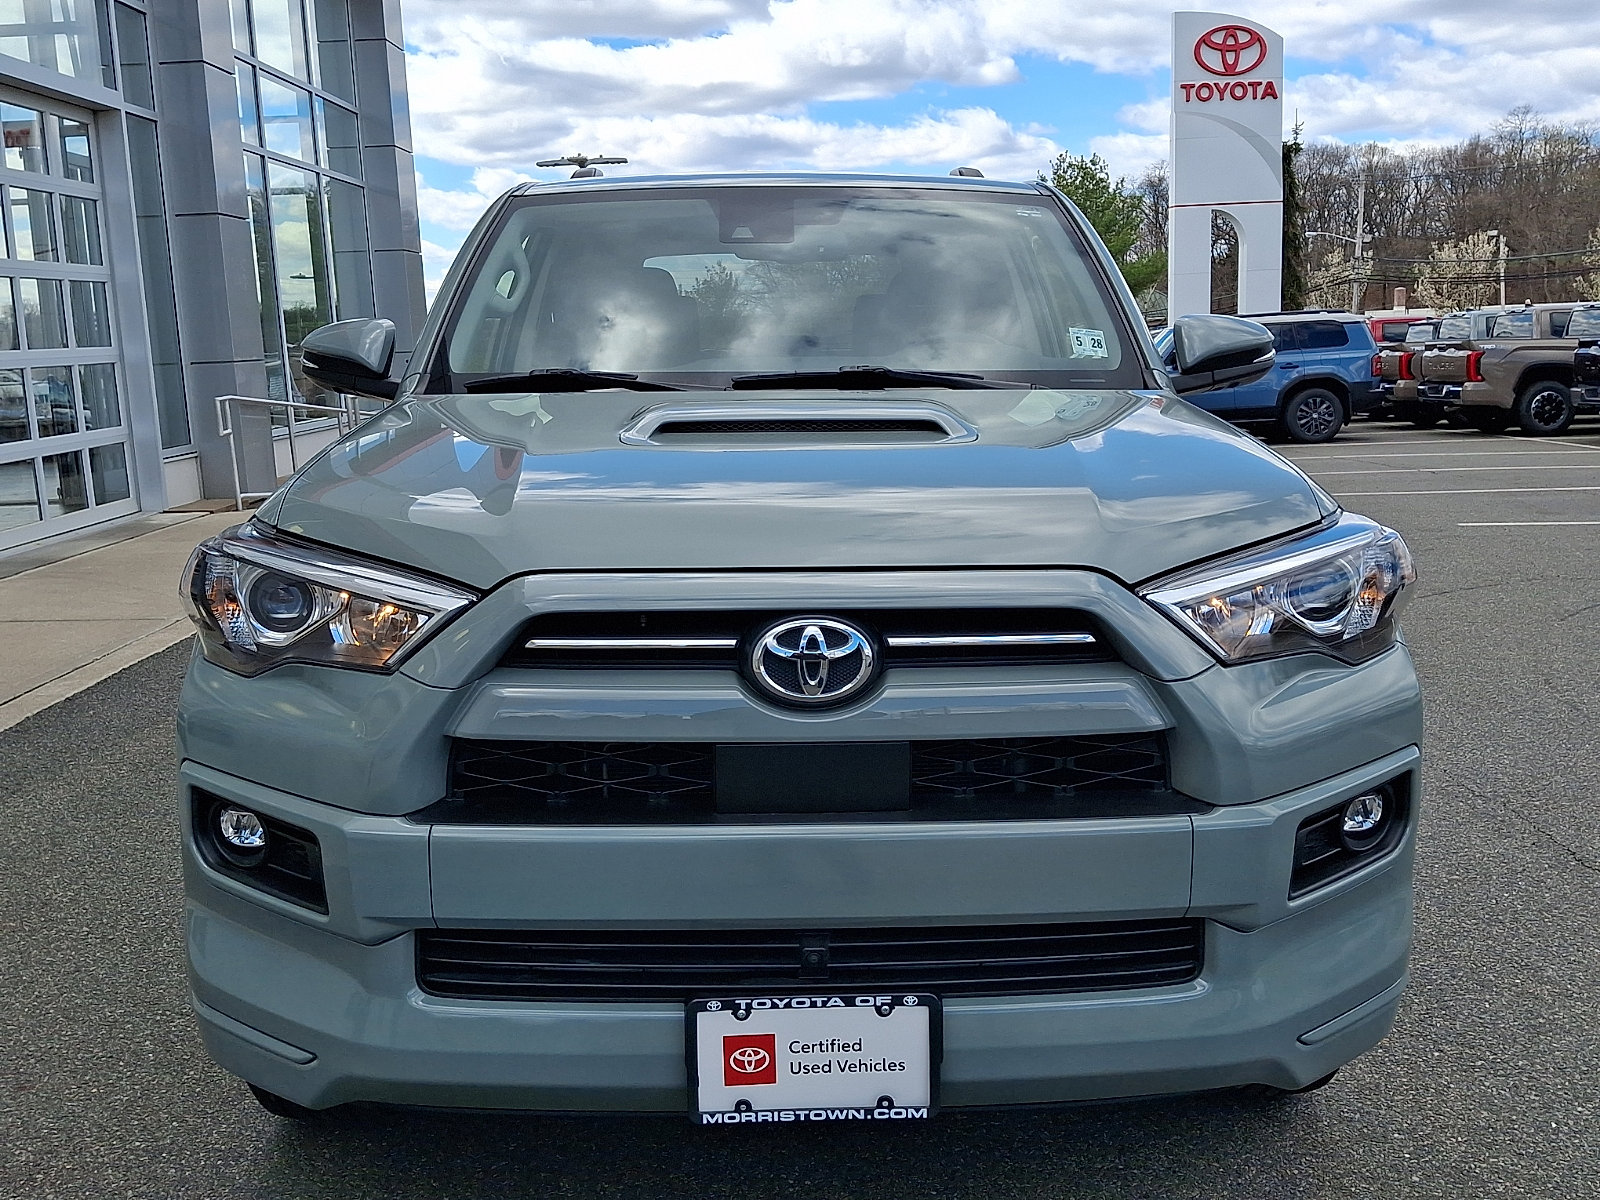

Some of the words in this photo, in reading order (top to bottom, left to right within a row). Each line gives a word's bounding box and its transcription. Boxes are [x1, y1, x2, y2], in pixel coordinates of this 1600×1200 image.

[1180, 81, 1278, 102] TOYOTA
[1075, 336, 1083, 346] 5
[1090, 337, 1103, 349] 28
[735, 997, 845, 1010] TOYOTA
[856, 996, 892, 1007] OF
[789, 1038, 862, 1054] Certified
[790, 1060, 832, 1075] Used
[836, 1057, 906, 1073] Vehicles
[703, 1108, 928, 1124] MORRISTOWN.COM
